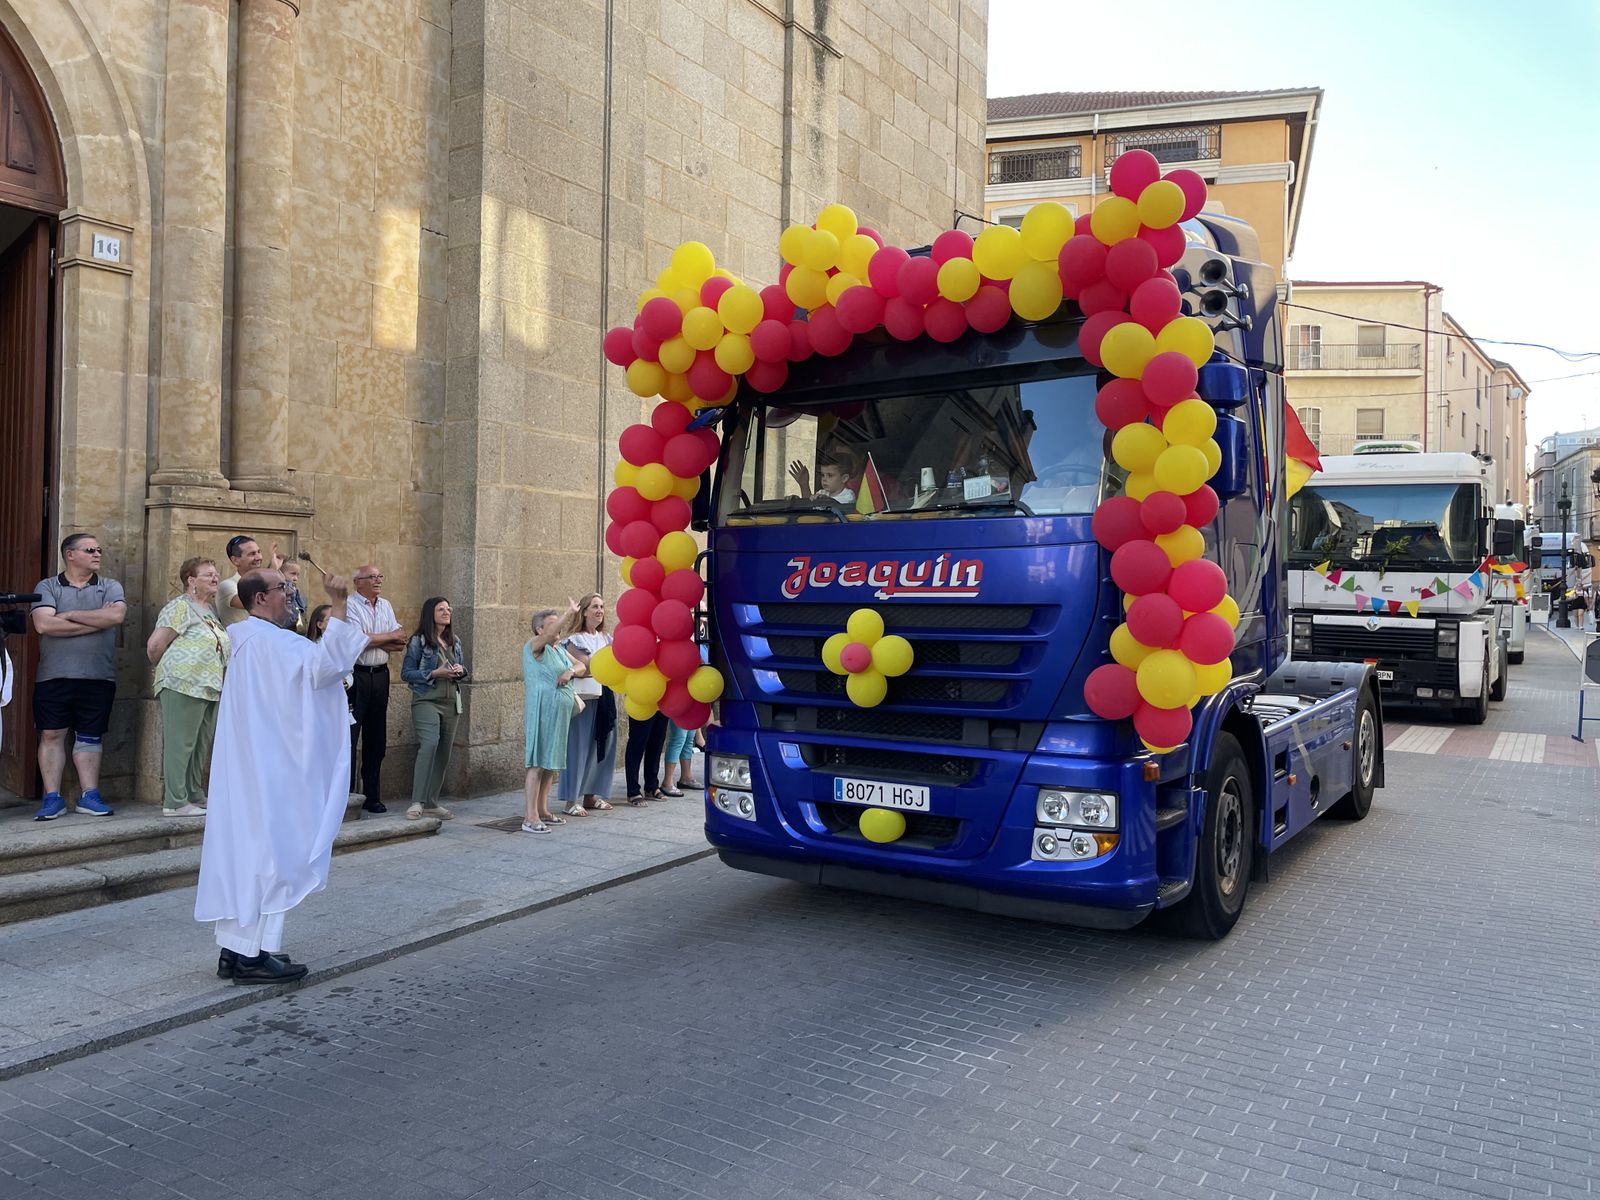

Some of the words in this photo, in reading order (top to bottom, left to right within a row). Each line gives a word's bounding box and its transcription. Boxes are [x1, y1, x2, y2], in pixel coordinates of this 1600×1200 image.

[96, 240, 118, 256] 16
[781, 552, 984, 600] Joaquin
[846, 782, 884, 803] 8071
[893, 786, 924, 807] HGJ
